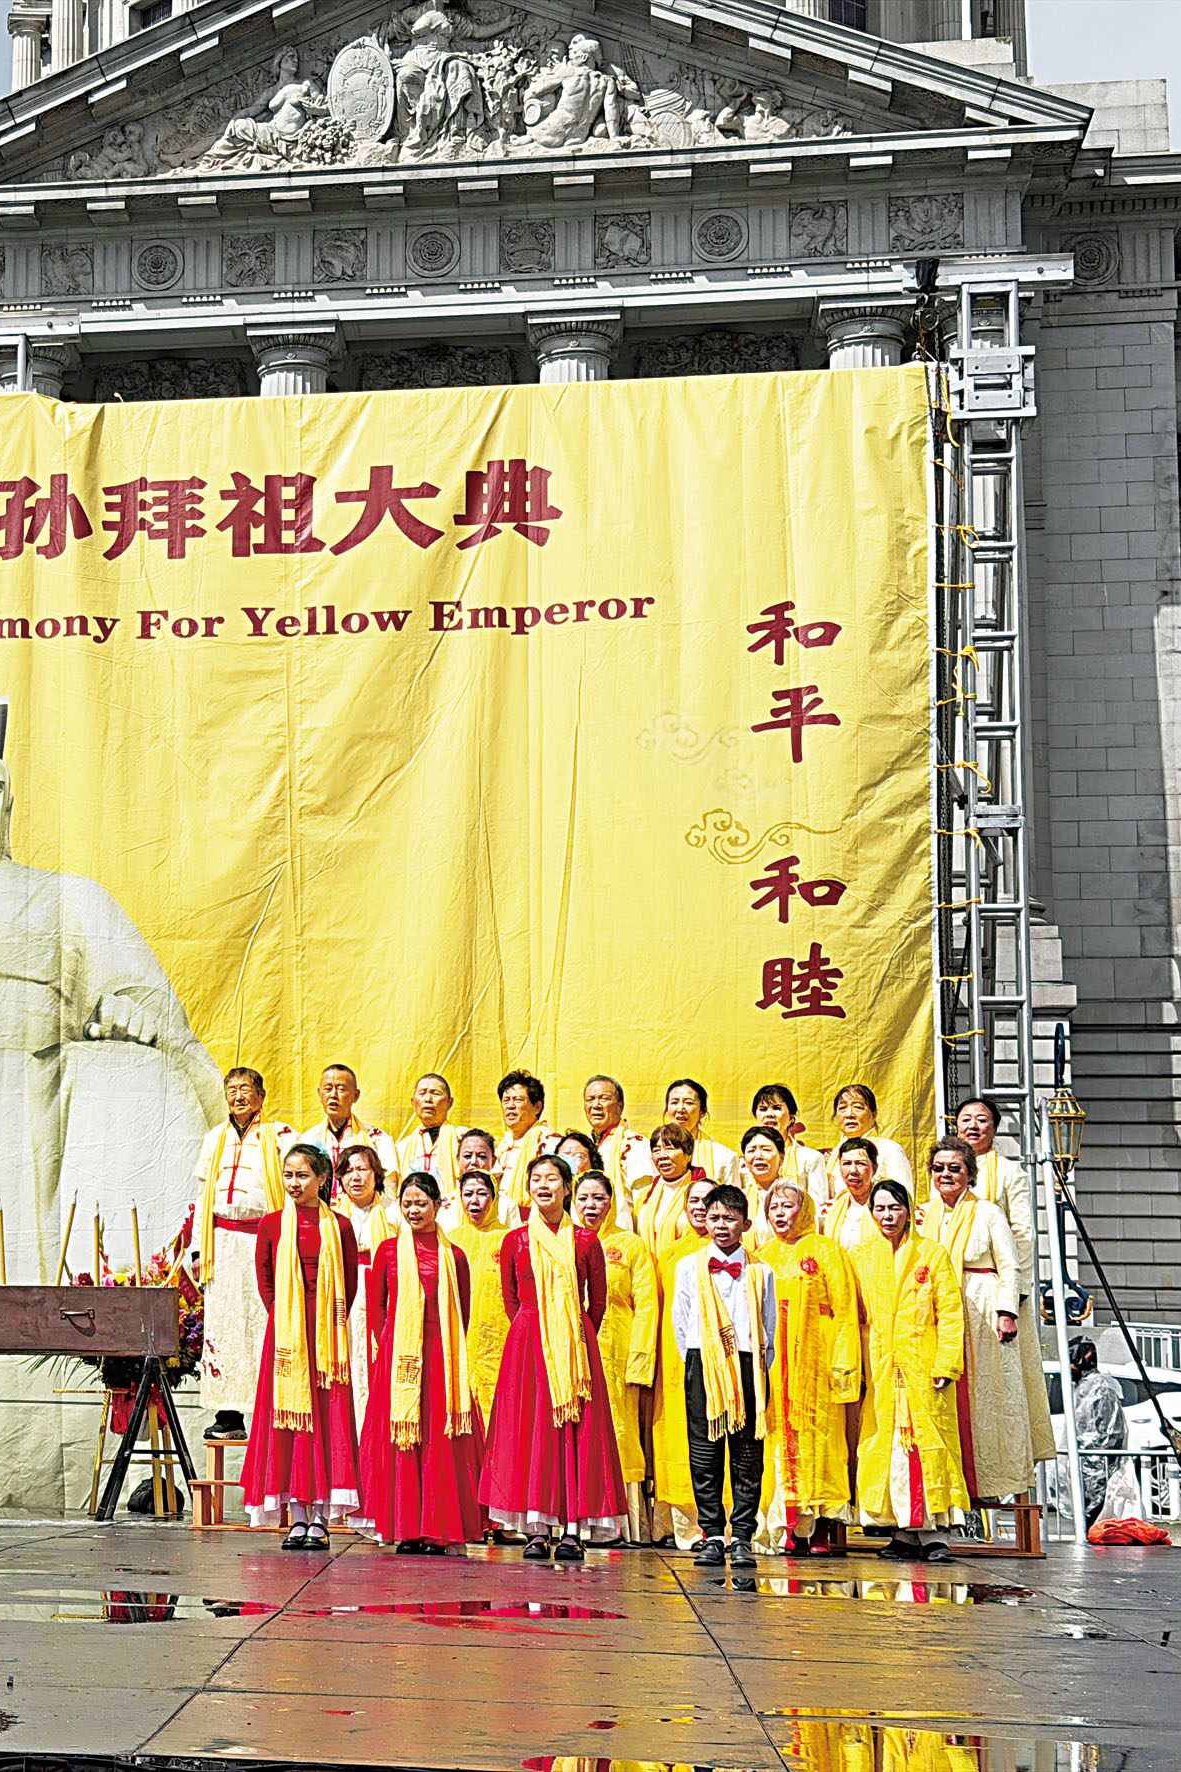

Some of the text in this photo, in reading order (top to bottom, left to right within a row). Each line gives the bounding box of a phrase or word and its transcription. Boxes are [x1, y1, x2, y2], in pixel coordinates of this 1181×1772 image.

[136, 610, 225, 639] For
[240, 605, 412, 638] Yellow
[429, 597, 657, 636] Emperor
[747, 600, 848, 1019] 和平 和睦
